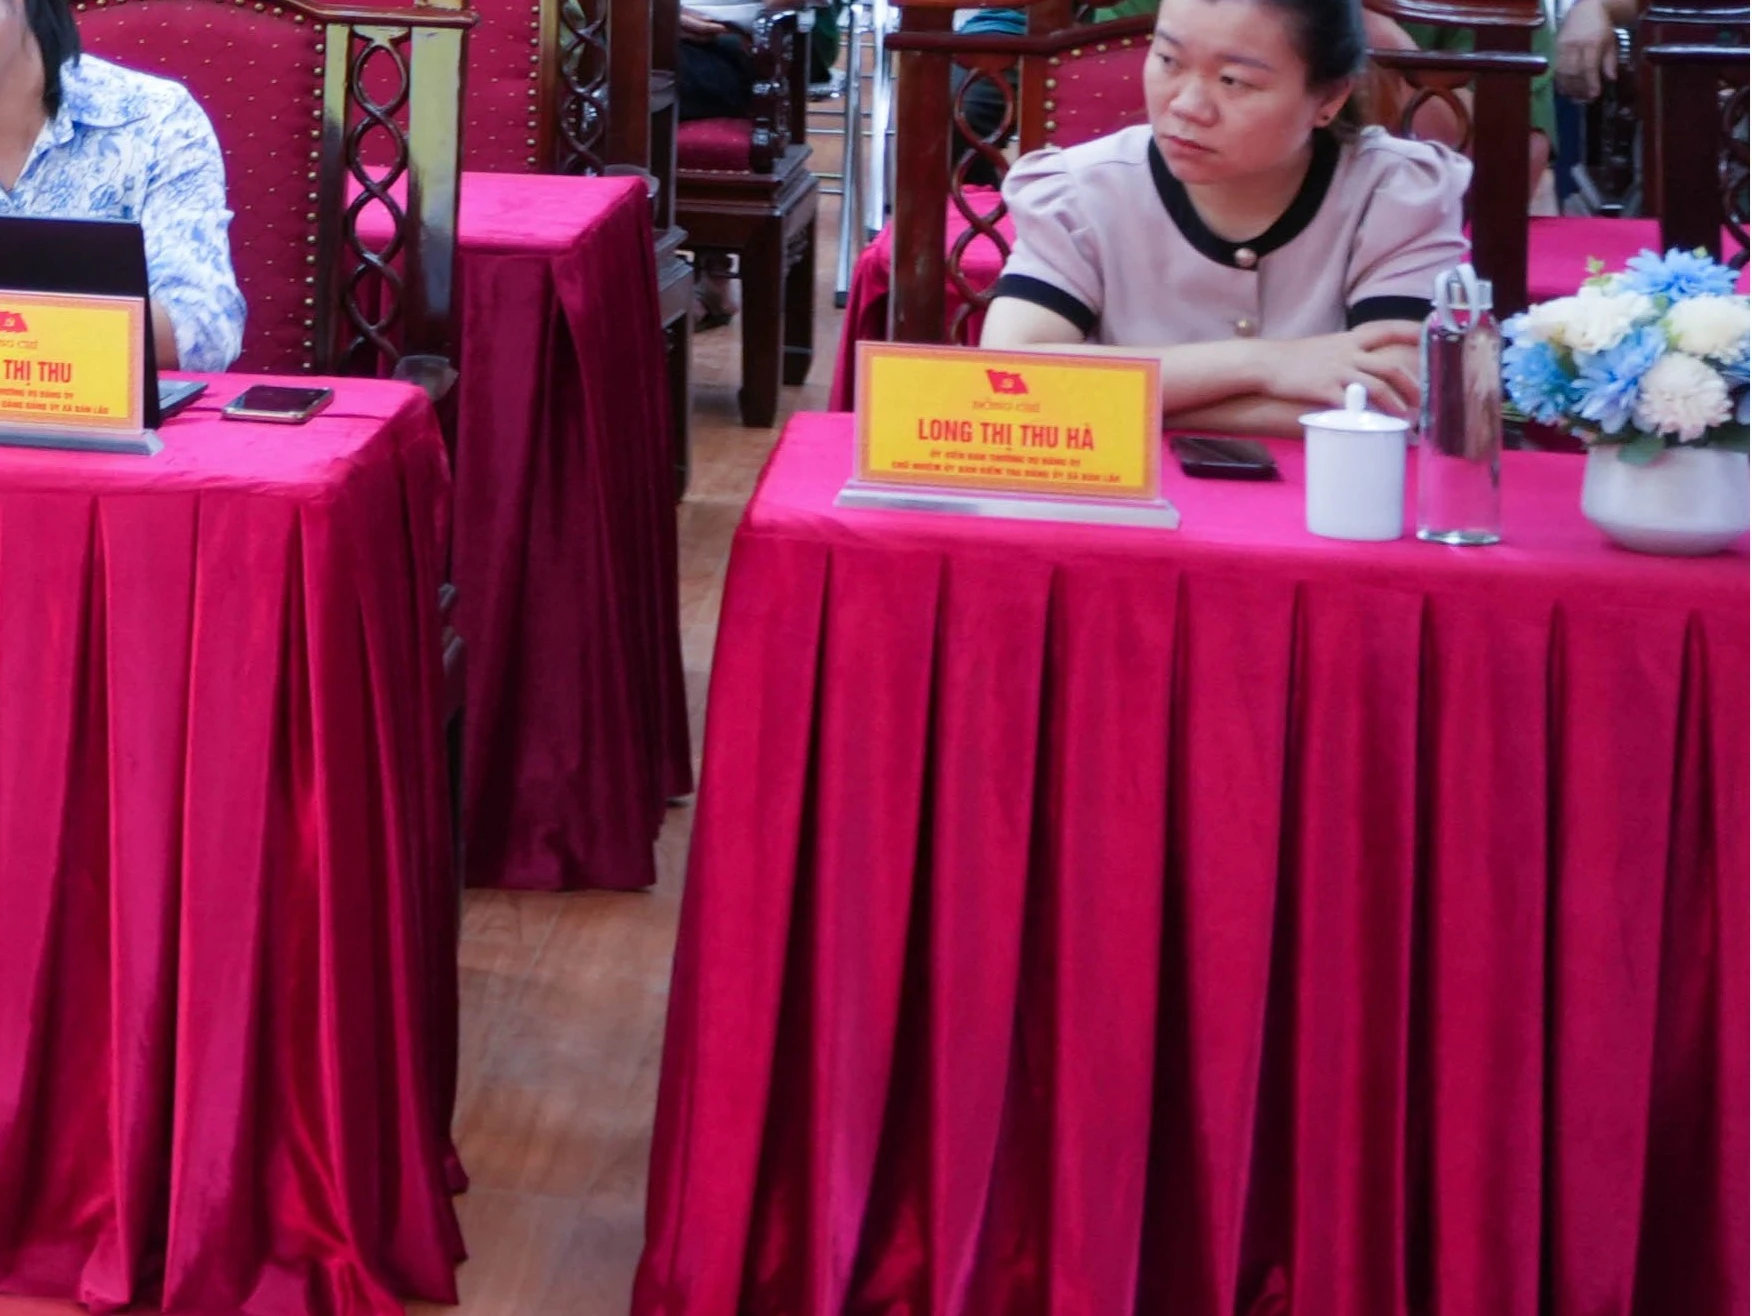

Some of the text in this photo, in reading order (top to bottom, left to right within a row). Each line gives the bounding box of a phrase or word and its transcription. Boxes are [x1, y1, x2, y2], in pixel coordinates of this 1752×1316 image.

[3, 358, 31, 386] THỊ
[38, 360, 73, 383] THU
[918, 418, 1095, 451] LONG THỊ THU HÀ
